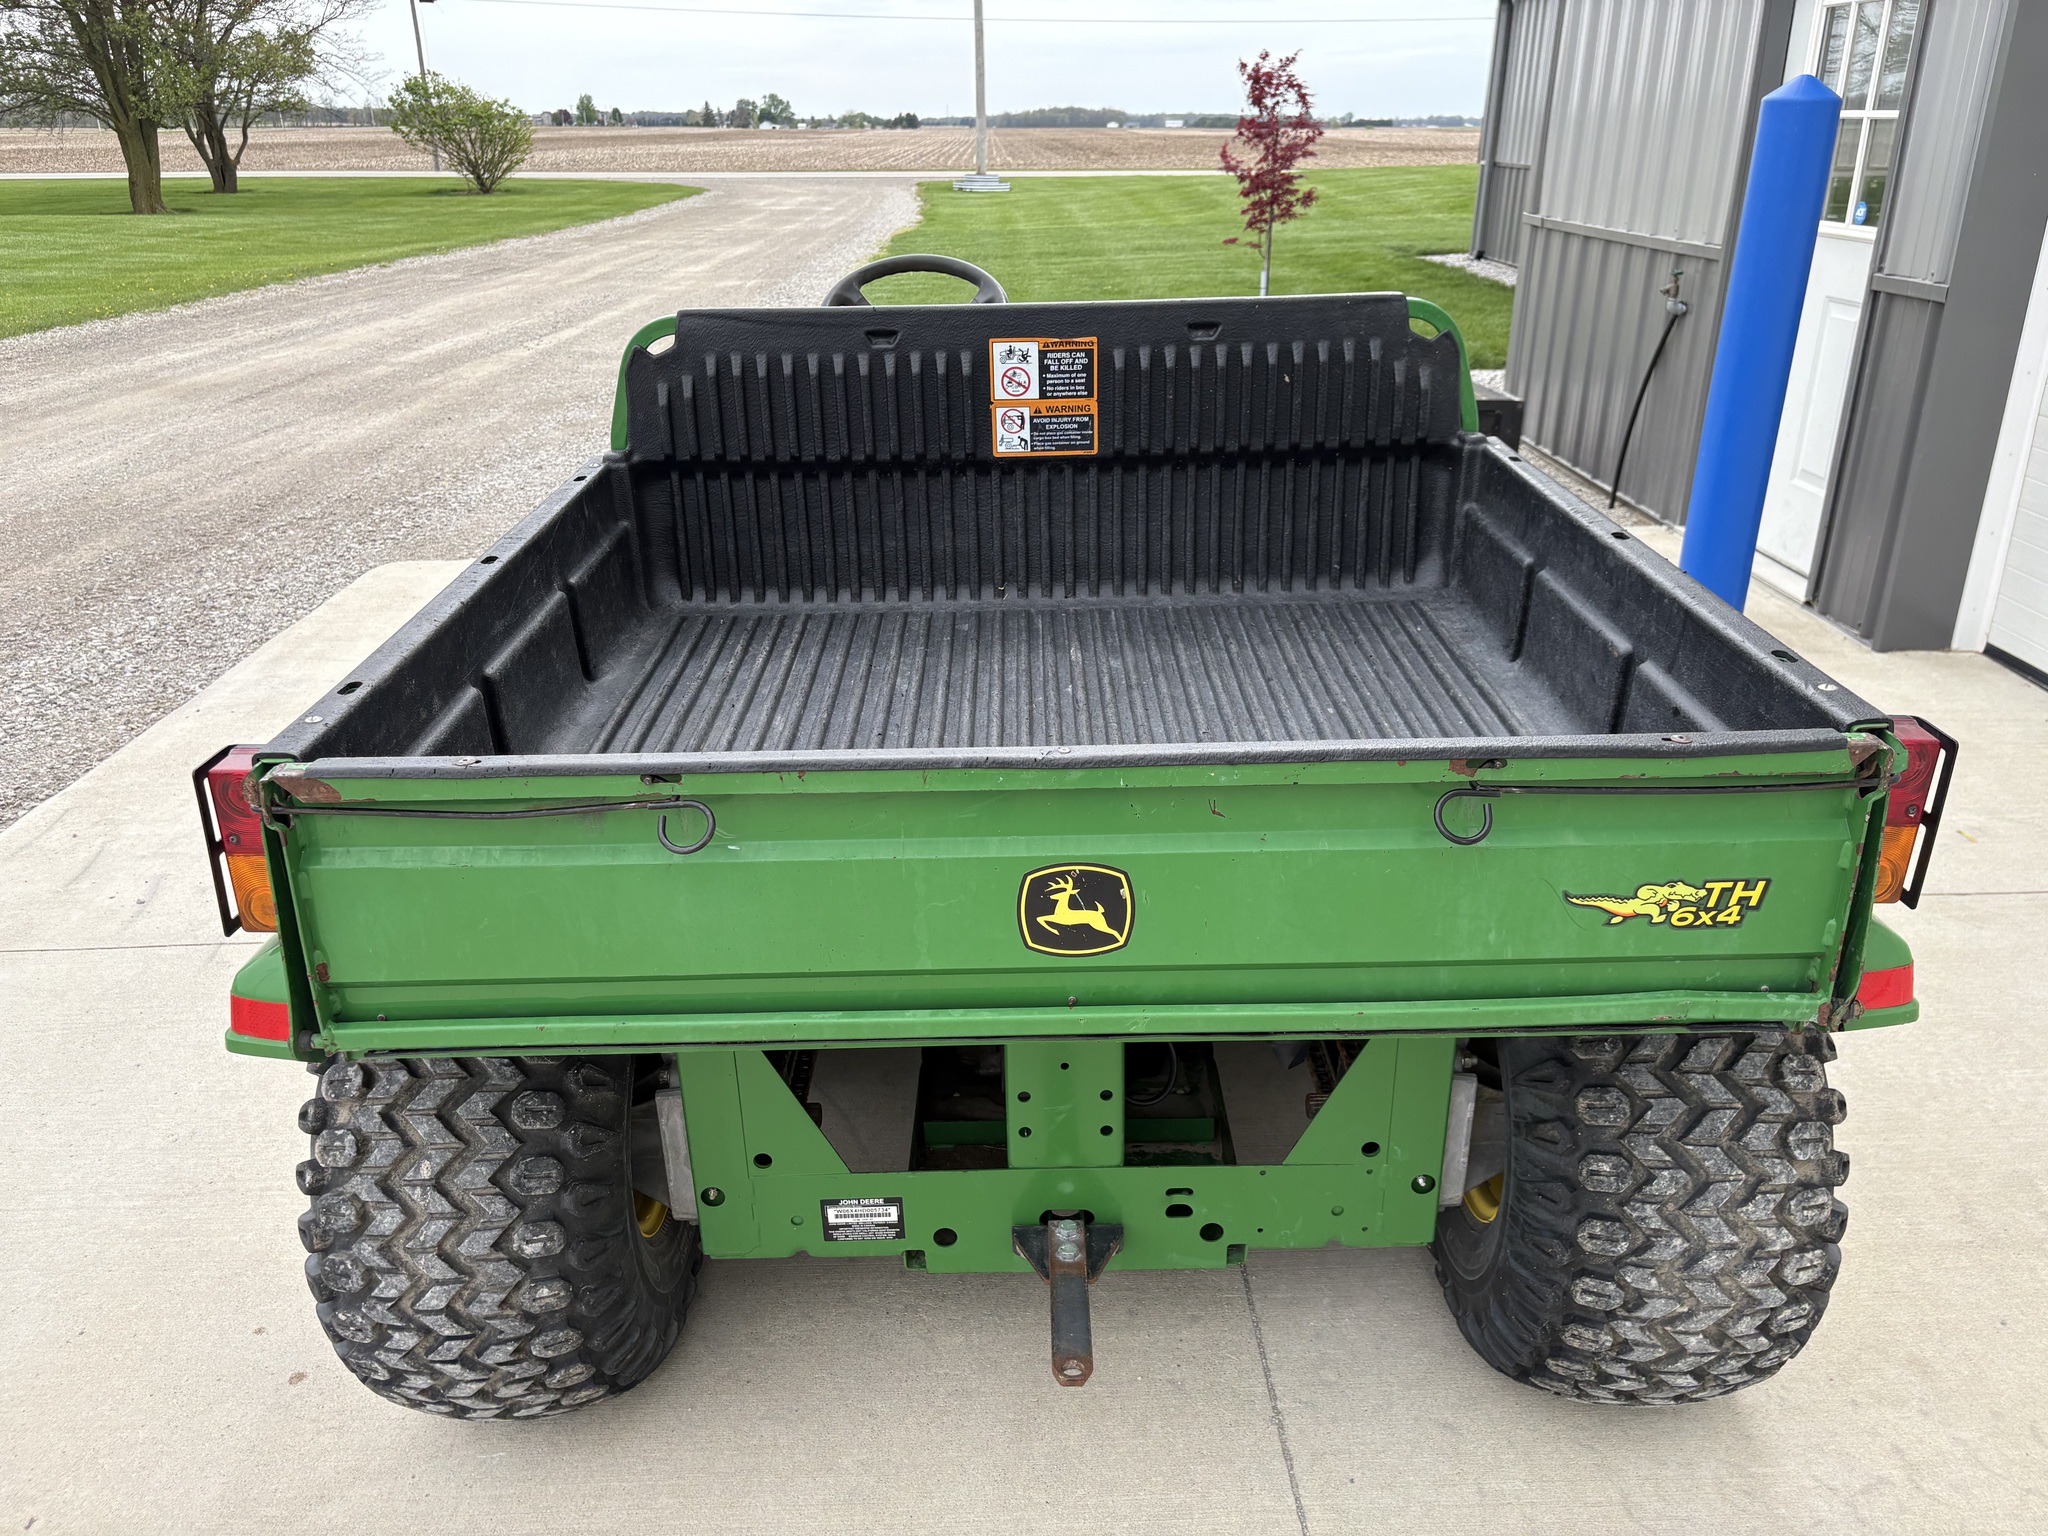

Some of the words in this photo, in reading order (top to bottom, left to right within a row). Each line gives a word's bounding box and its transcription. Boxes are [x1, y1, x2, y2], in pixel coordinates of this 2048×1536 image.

[1050, 340, 1094, 348] WARNING
[1045, 404, 1091, 413] WARNING
[1704, 880, 1767, 908] TH
[1669, 905, 1742, 927] 6x4
